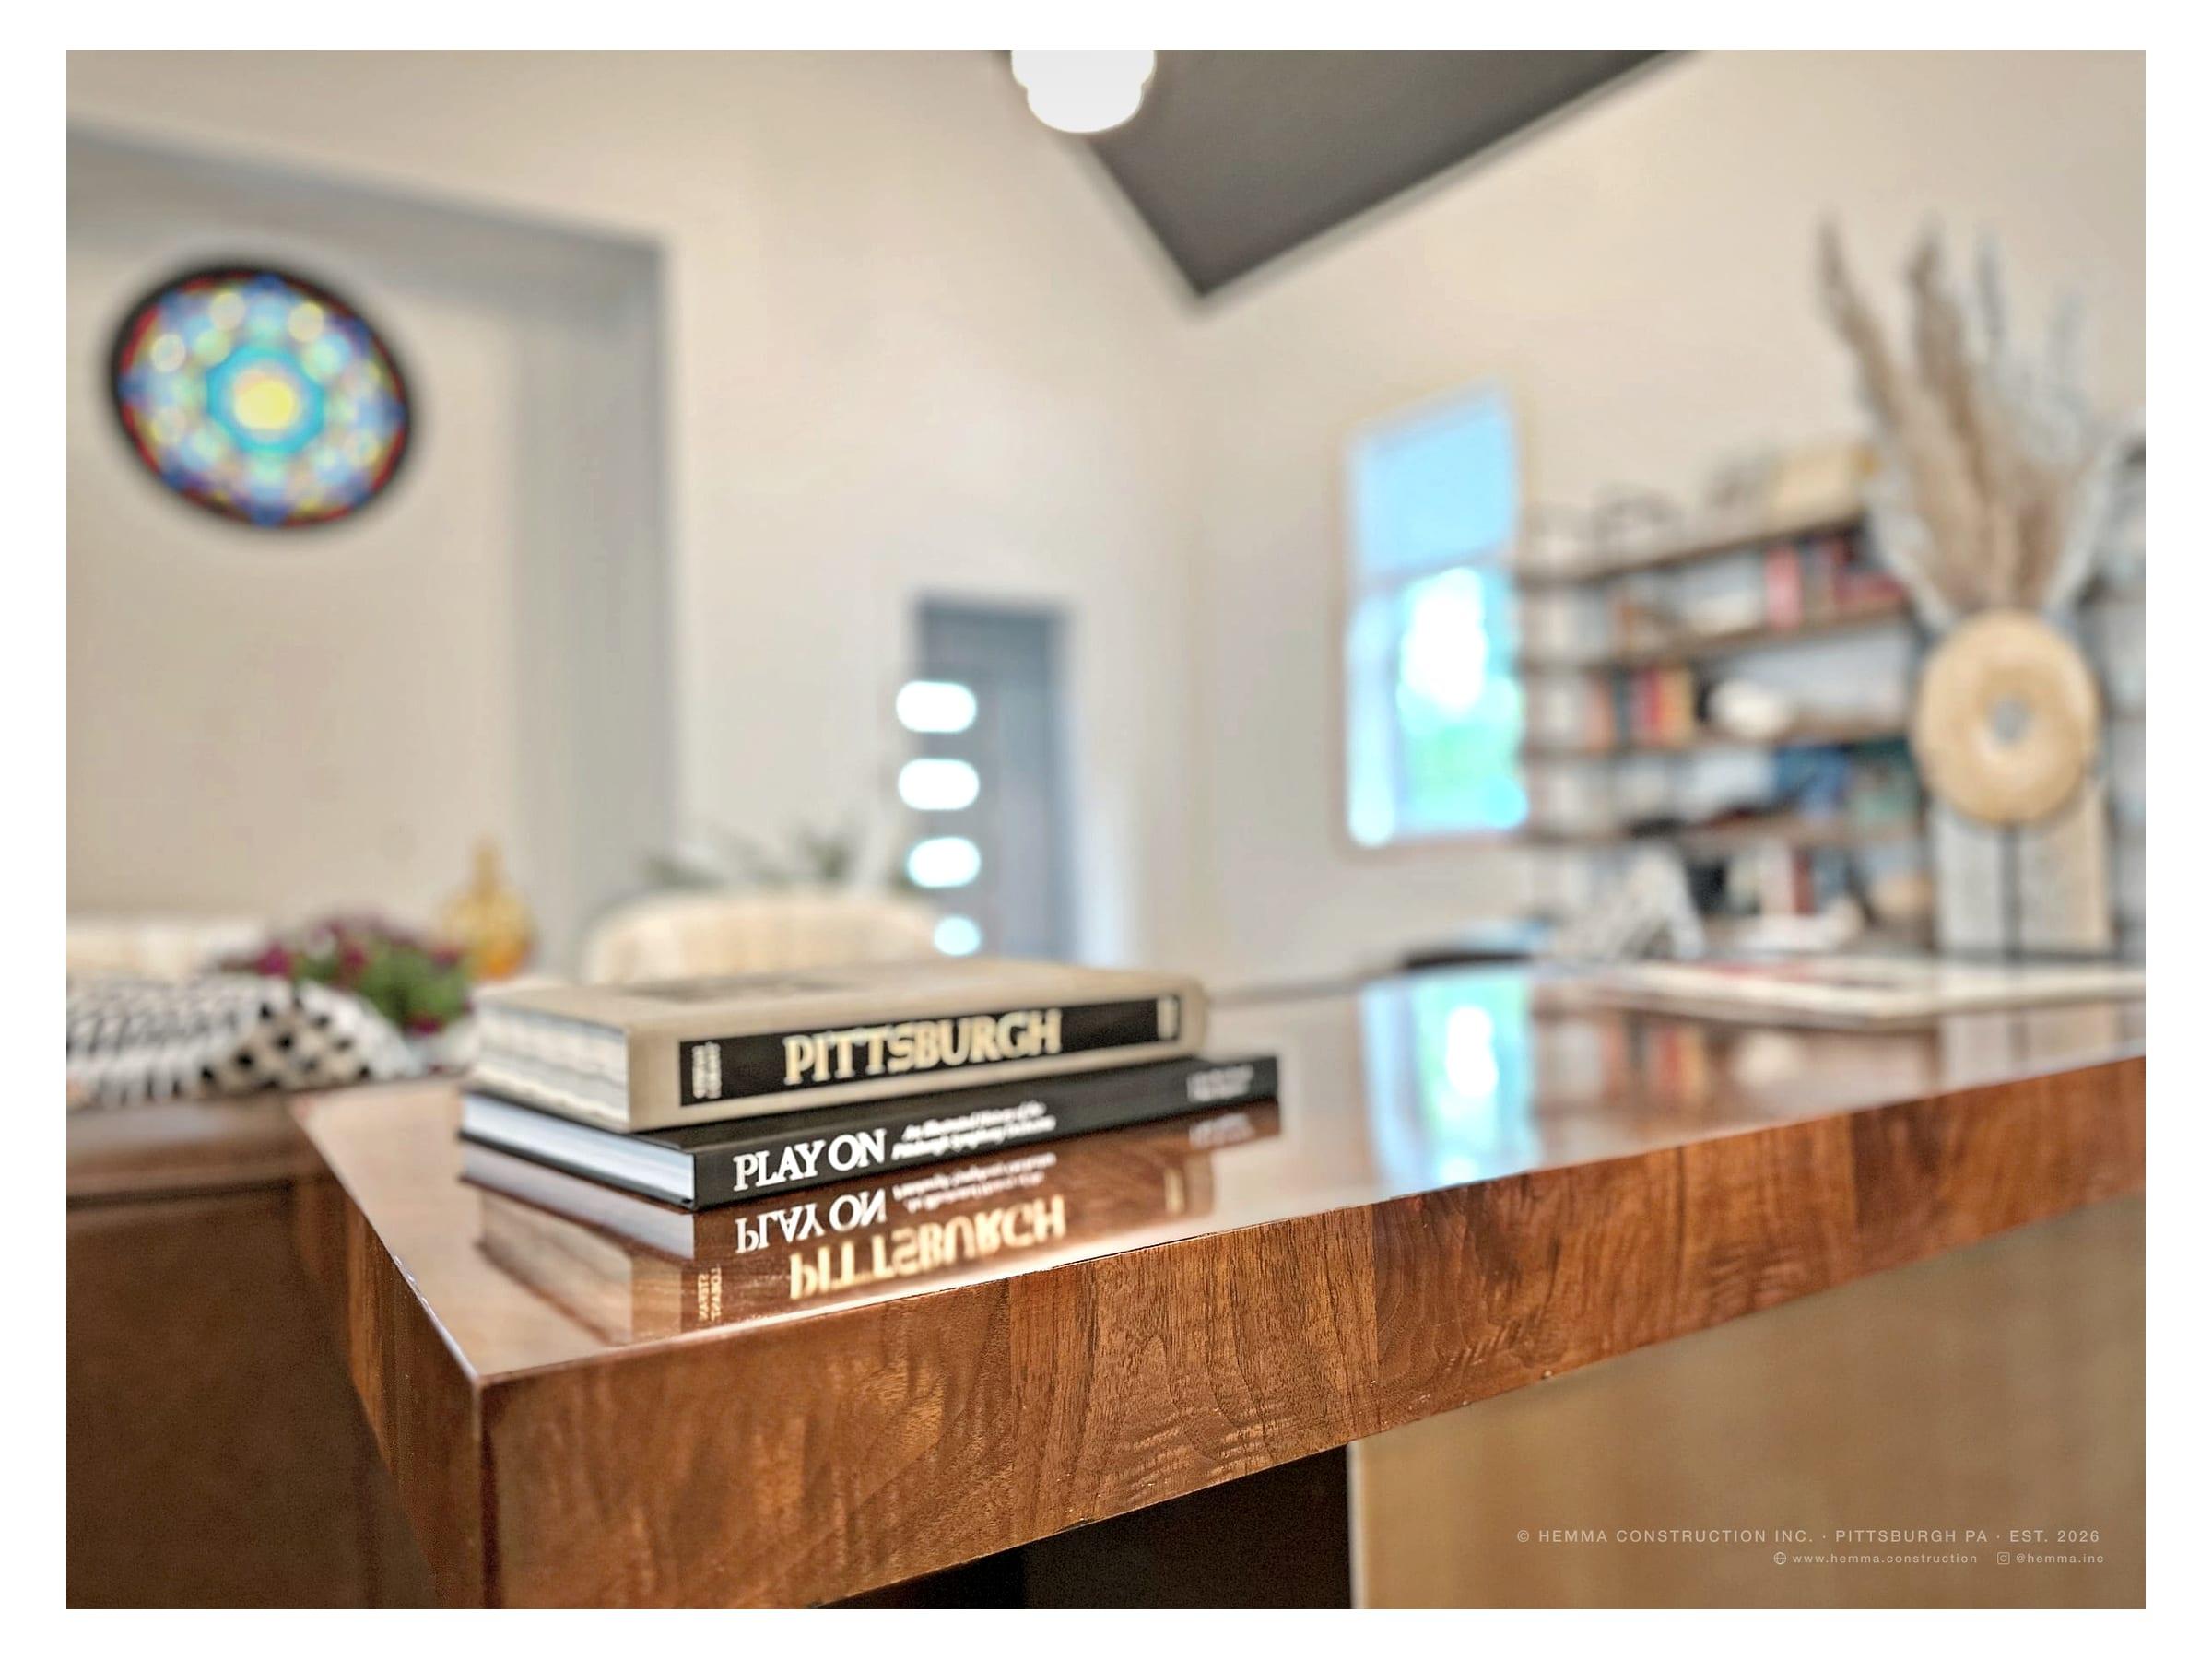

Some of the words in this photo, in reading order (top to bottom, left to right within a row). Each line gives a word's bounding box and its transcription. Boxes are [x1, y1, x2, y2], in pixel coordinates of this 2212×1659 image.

[783, 1008, 1061, 1085] PITTSBURGH
[733, 1139, 826, 1191] PLAY
[828, 1128, 887, 1171] ON
